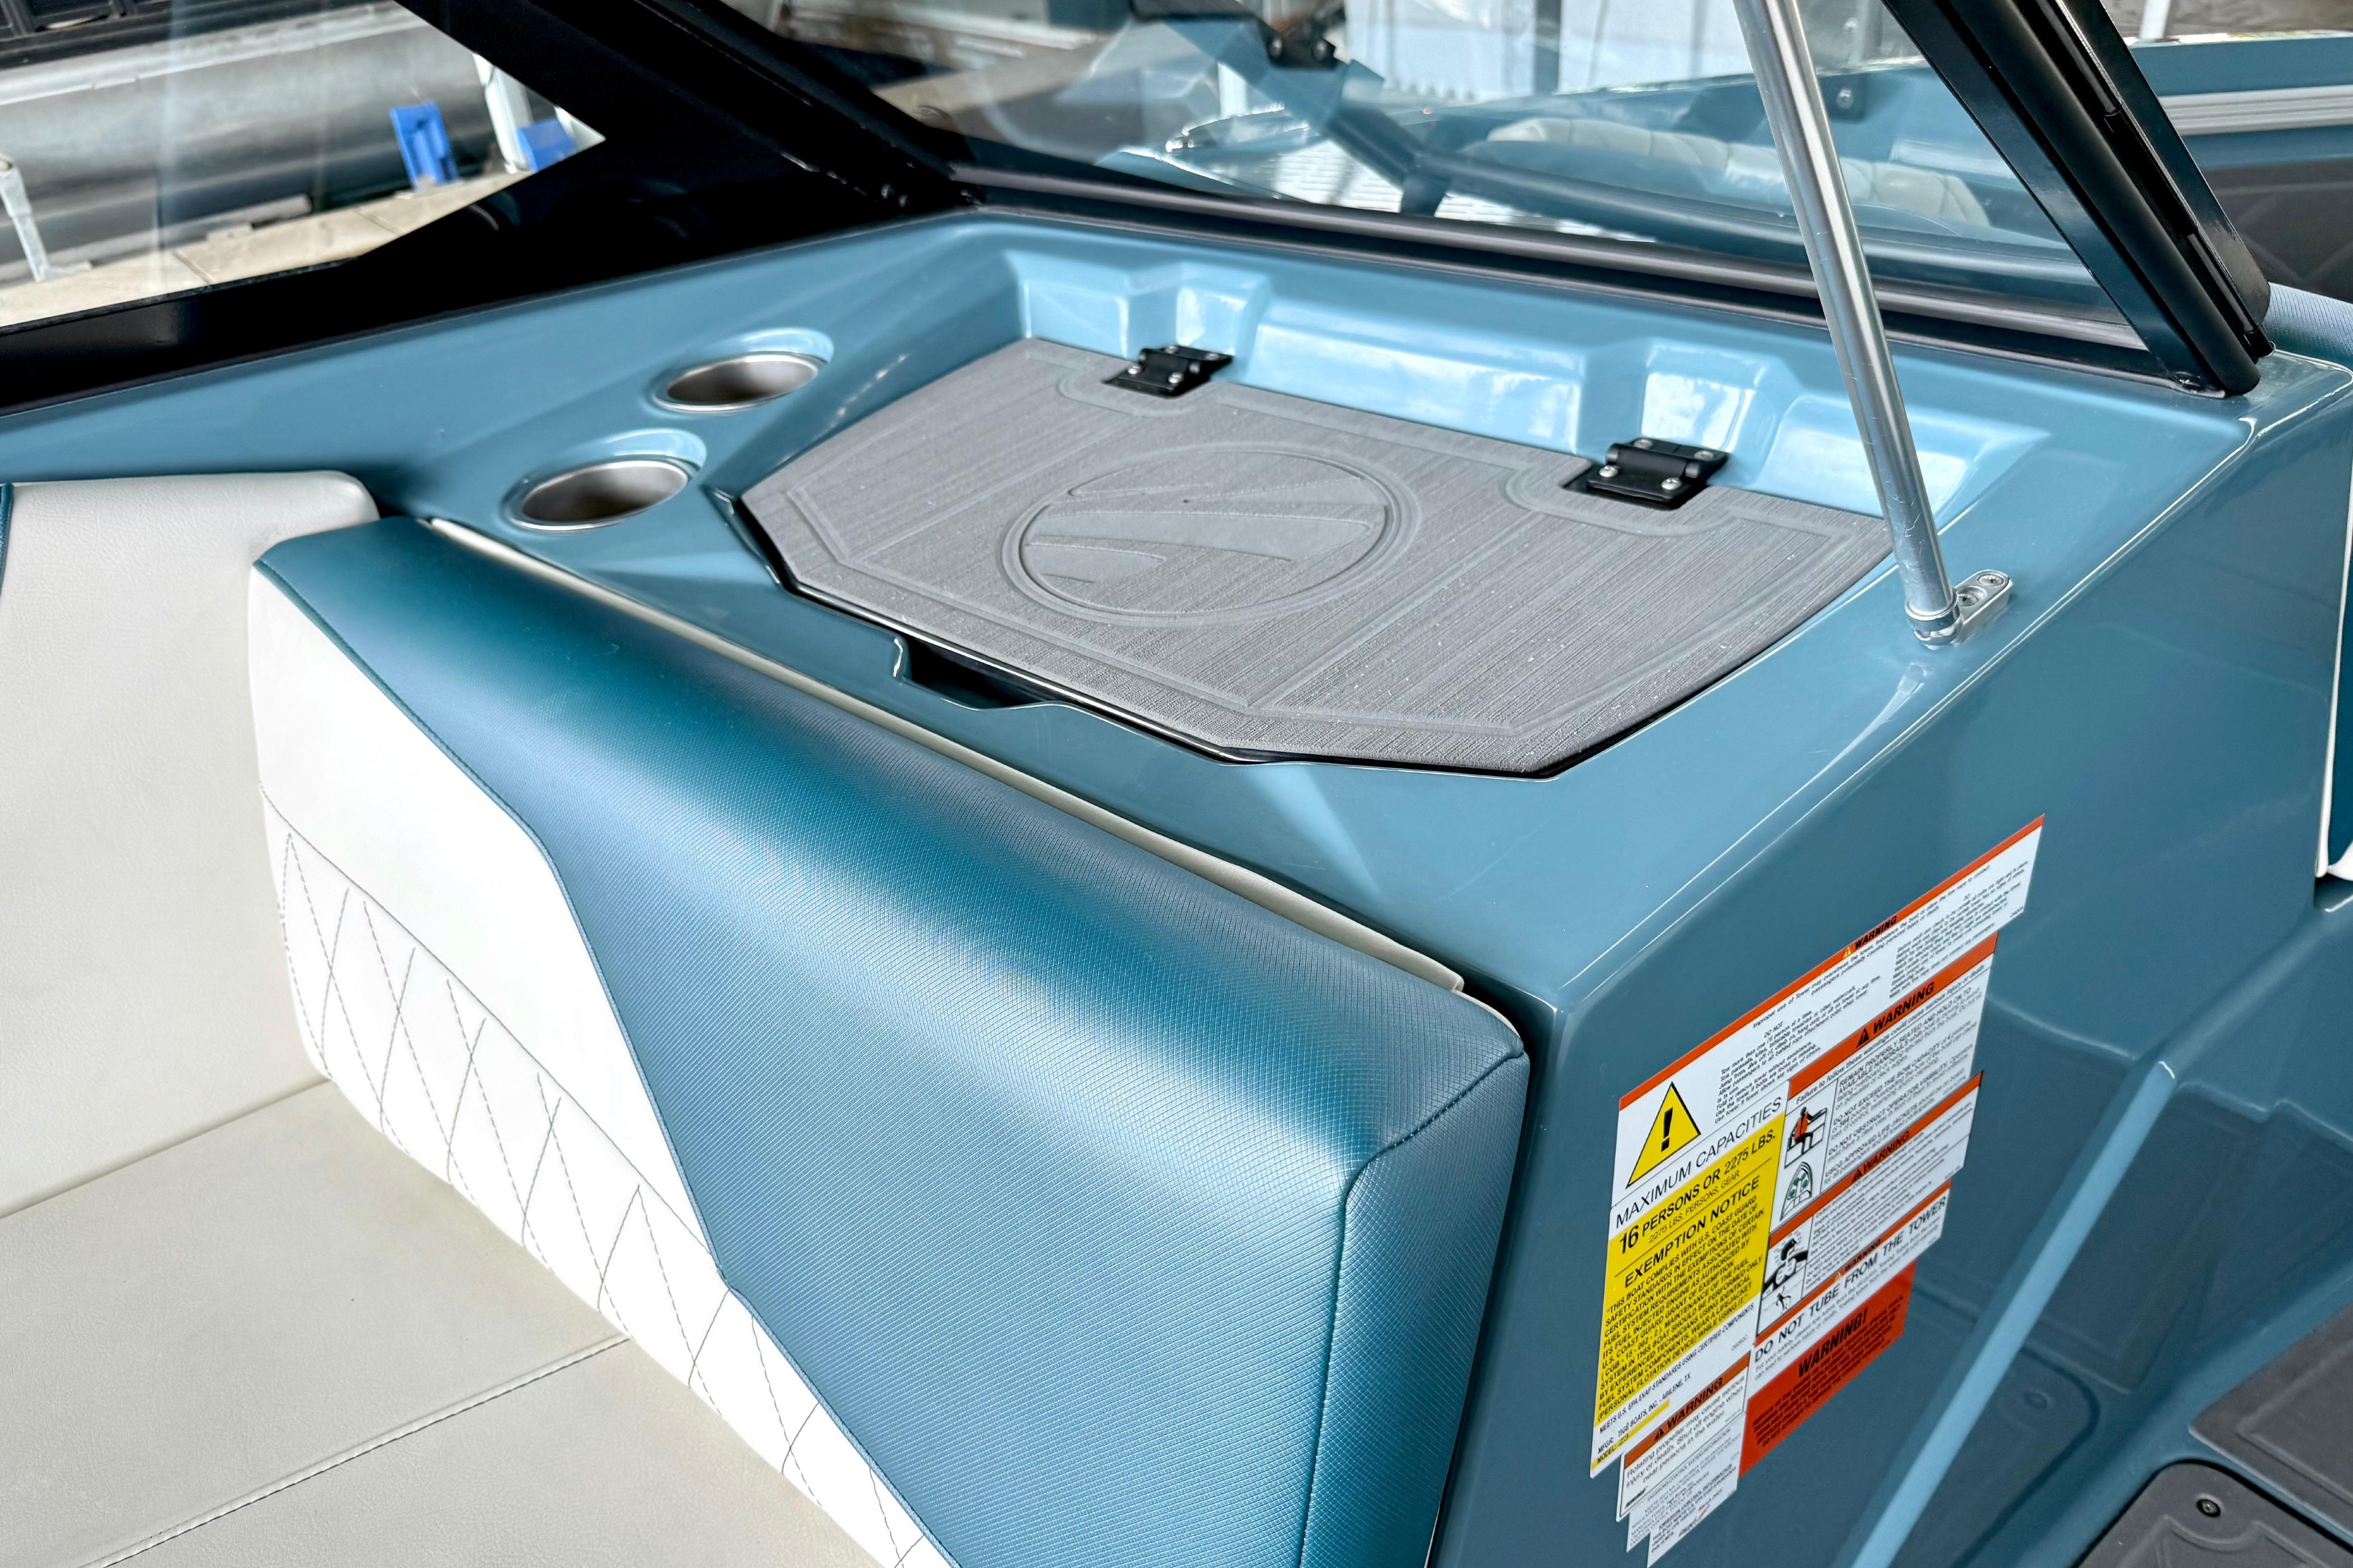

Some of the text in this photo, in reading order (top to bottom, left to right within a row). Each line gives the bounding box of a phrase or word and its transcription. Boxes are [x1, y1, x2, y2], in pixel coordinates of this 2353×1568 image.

[1855, 916, 1896, 949] WARNING
[1752, 1009, 1775, 1029] Improper
[1763, 1021, 1783, 1039] DO NOT
[1874, 982, 1934, 1033] WARNING
[1796, 1084, 1818, 1105] Failure
[1819, 1079, 1825, 1088] to
[1826, 1065, 1844, 1083] follow
[1838, 1065, 1872, 1095] AVAILABLE
[1839, 1066, 1863, 1087] REMAIN
[1865, 1041, 1897, 1069] PROPERLY
[1828, 1144, 1838, 1156] DO
[1839, 1133, 1852, 1148] NOT
[1833, 1113, 1843, 1125] DO
[1844, 1103, 1857, 1117] NOT
[1617, 1162, 1691, 1228] MAXIMUM
[1696, 1097, 1781, 1167] CAPACITIES
[1863, 1131, 1909, 1173] WARNING
[1620, 1129, 1775, 1254] 16 PERSONS OR 2275 LBS.
[1648, 1169, 1739, 1244] 2275 GEAR
[1606, 1203, 1757, 1327] SAFETY STANDARDS IN EFFECT ON THE DATE OF
[1625, 1216, 1706, 1287] EXEMPTION
[1710, 1176, 1759, 1222] NOTICE
[1626, 1195, 1756, 1300] BOAT COMPLIES WITH U.S. COAST GUARD
[1845, 1239, 1881, 1272] WARNING
[1603, 1238, 1749, 1359] ITS FUEL INJECTED ENGINE AS AUTHORIZED BY
[1604, 1222, 1757, 1348] FUEL SYSTEM REQUIREMENTS ASSOCIATED WITH
[1605, 1208, 1764, 1337] CERTIFICATION WITH THE EXEMPTIONS OF CERTAIN
[1754, 1340, 1773, 1363] DO
[1778, 1313, 1804, 1343] NOT
[1810, 1284, 1840, 1316] TUBE
[1844, 1253, 1878, 1288] FROM
[1883, 1231, 1904, 1256] THE
[1909, 1196, 1946, 1234] TOWER
[1599, 1387, 1608, 1401] BY
[1610, 1351, 1655, 1391] EXPERIENCED
[1657, 1316, 1698, 1352] TECHNICIANS
[1700, 1298, 1719, 1319] USING
[1720, 1275, 1750, 1302] IDENTICAL
[1601, 1256, 1761, 1390] SYSTEM IN THIS BOAT SHOULD BE PERFORMED ONLY
[1602, 1260, 1734, 1369] U.S. COAST GUARD GRANT OF EXEMPTION
[1605, 1359, 1620, 1376] CGB
[1626, 1349, 1633, 1360] 15
[1637, 1336, 1648, 1350] 002
[1664, 1288, 1709, 1328] MAINTENANCE
[1710, 1279, 1720, 1292] OF
[1721, 1270, 1733, 1283] THE
[1733, 1257, 1749, 1274] FUEL
[1799, 1310, 1867, 1376] WARNING!
[1598, 1386, 1635, 1421] (PERSONAL
[1637, 1356, 1671, 1388] FLOTATION
[1698, 1318, 1717, 1338] WHILE
[1718, 1301, 1737, 1322] USING
[1599, 1392, 1615, 1411] FUEL
[1617, 1369, 1643, 1395] SYSTEM
[1691, 1315, 1710, 1335] WEAR
[1599, 1415, 1617, 1434] MEETS
[1628, 1397, 1638, 1411] EPA
[1638, 1386, 1651, 1402] EVAP
[1652, 1362, 1681, 1390] STANDARDS
[1627, 1451, 1654, 1478] Rotating
[1686, 1412, 1700, 1428] may
[1701, 1395, 1721, 1415] cause
[1667, 1377, 1722, 1429] WARNING
[1643, 1466, 1658, 1483] near
[1646, 1462, 1653, 1471] or
[1677, 1427, 1692, 1445] Shut
